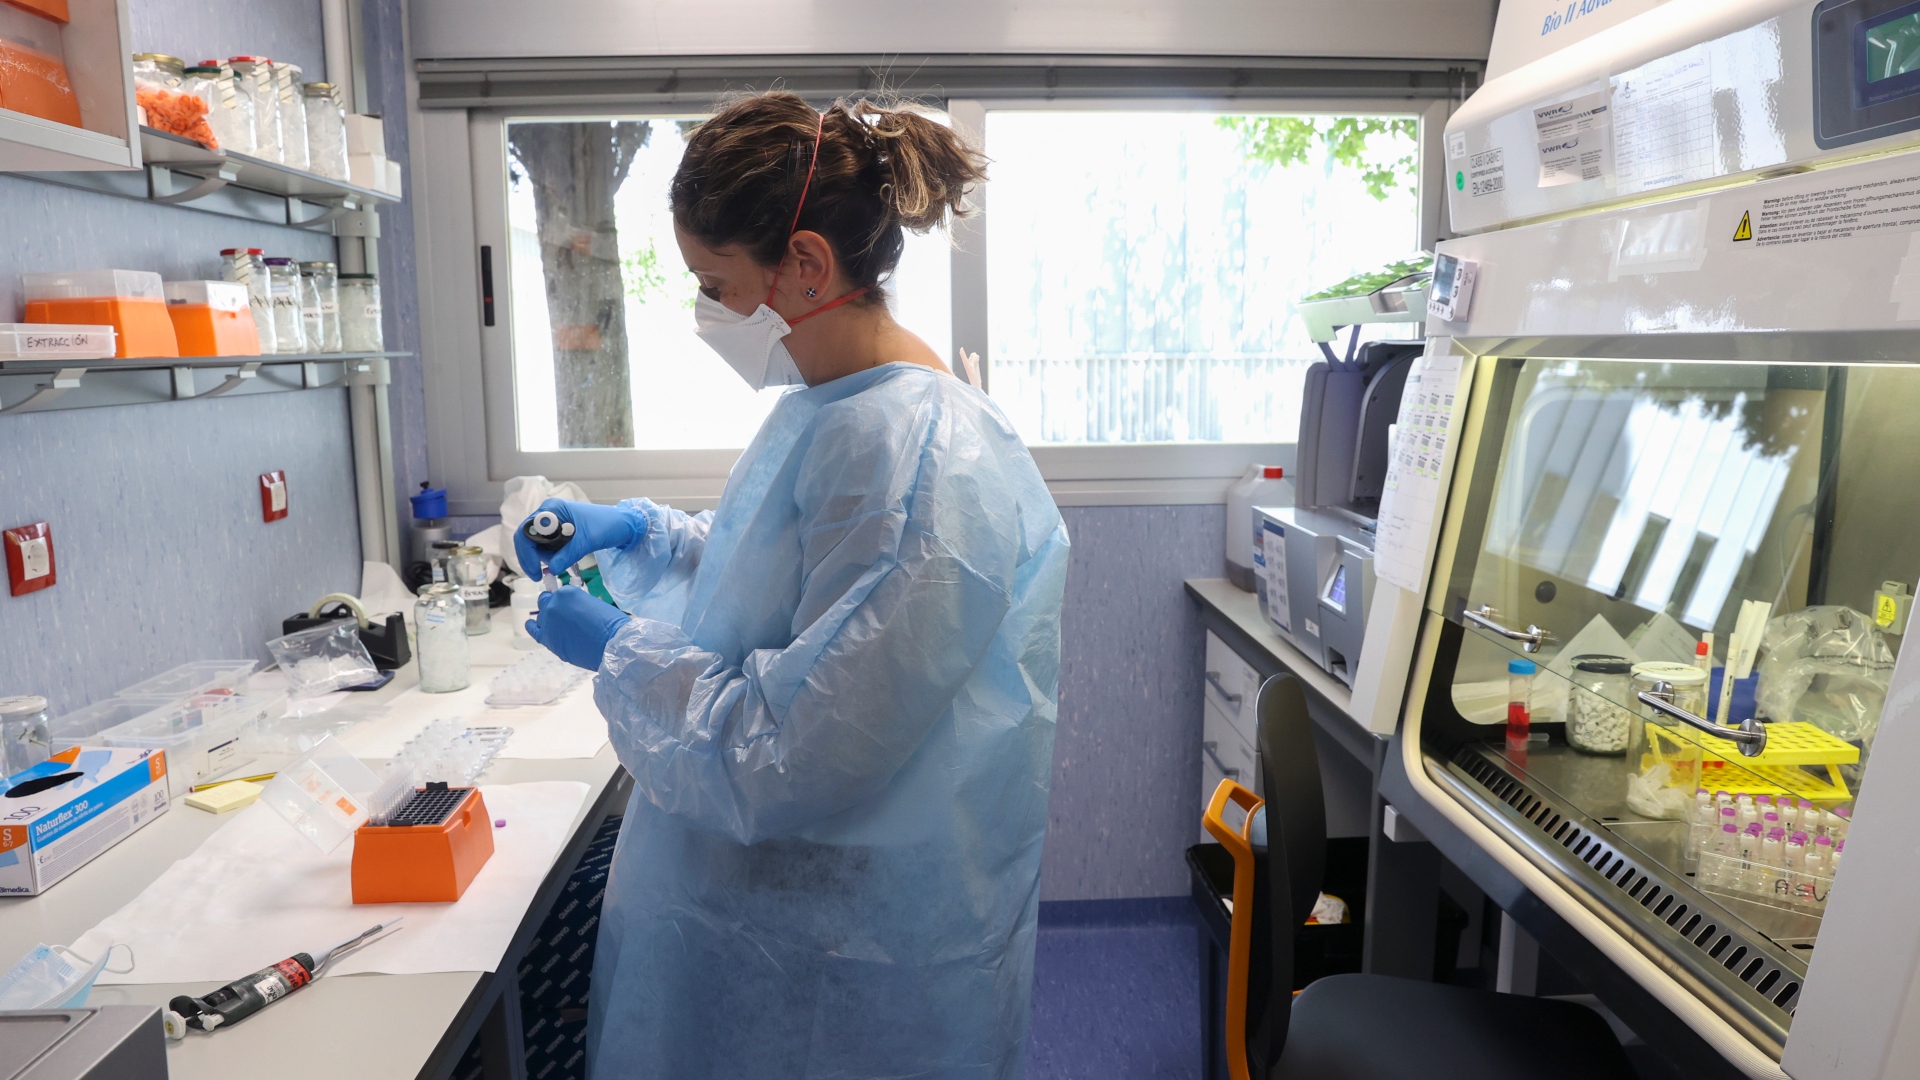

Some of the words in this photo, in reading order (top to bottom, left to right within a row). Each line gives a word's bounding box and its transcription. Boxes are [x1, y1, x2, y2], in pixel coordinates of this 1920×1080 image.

[1541, 11, 1562, 36] Bio
[1564, 2, 1577, 24] II
[1538, 109, 1558, 118] VWR
[1542, 145, 1561, 153] VWR
[27, 334, 88, 348] EXTRACCIÓN
[156, 758, 160, 769] S
[75, 800, 88, 814] 300
[3, 828, 12, 841] S
[37, 831, 53, 842] Guantes
[59, 820, 73, 830] examen
[558, 898, 579, 920] QIAGEN
[578, 915, 598, 936] QIAGEN
[549, 926, 570, 947] QIAGEN
[569, 942, 589, 963] QIAGEN
[541, 953, 561, 973] QIAGEN
[532, 979, 552, 999] QIAGEN
[560, 969, 580, 989] QIAGEN
[526, 1018, 546, 1038] QIAGEN
[545, 1034, 565, 1054] QIAGEN
[537, 1060, 557, 1079] QIAGEN
[564, 1050, 584, 1070] QIAGEN
